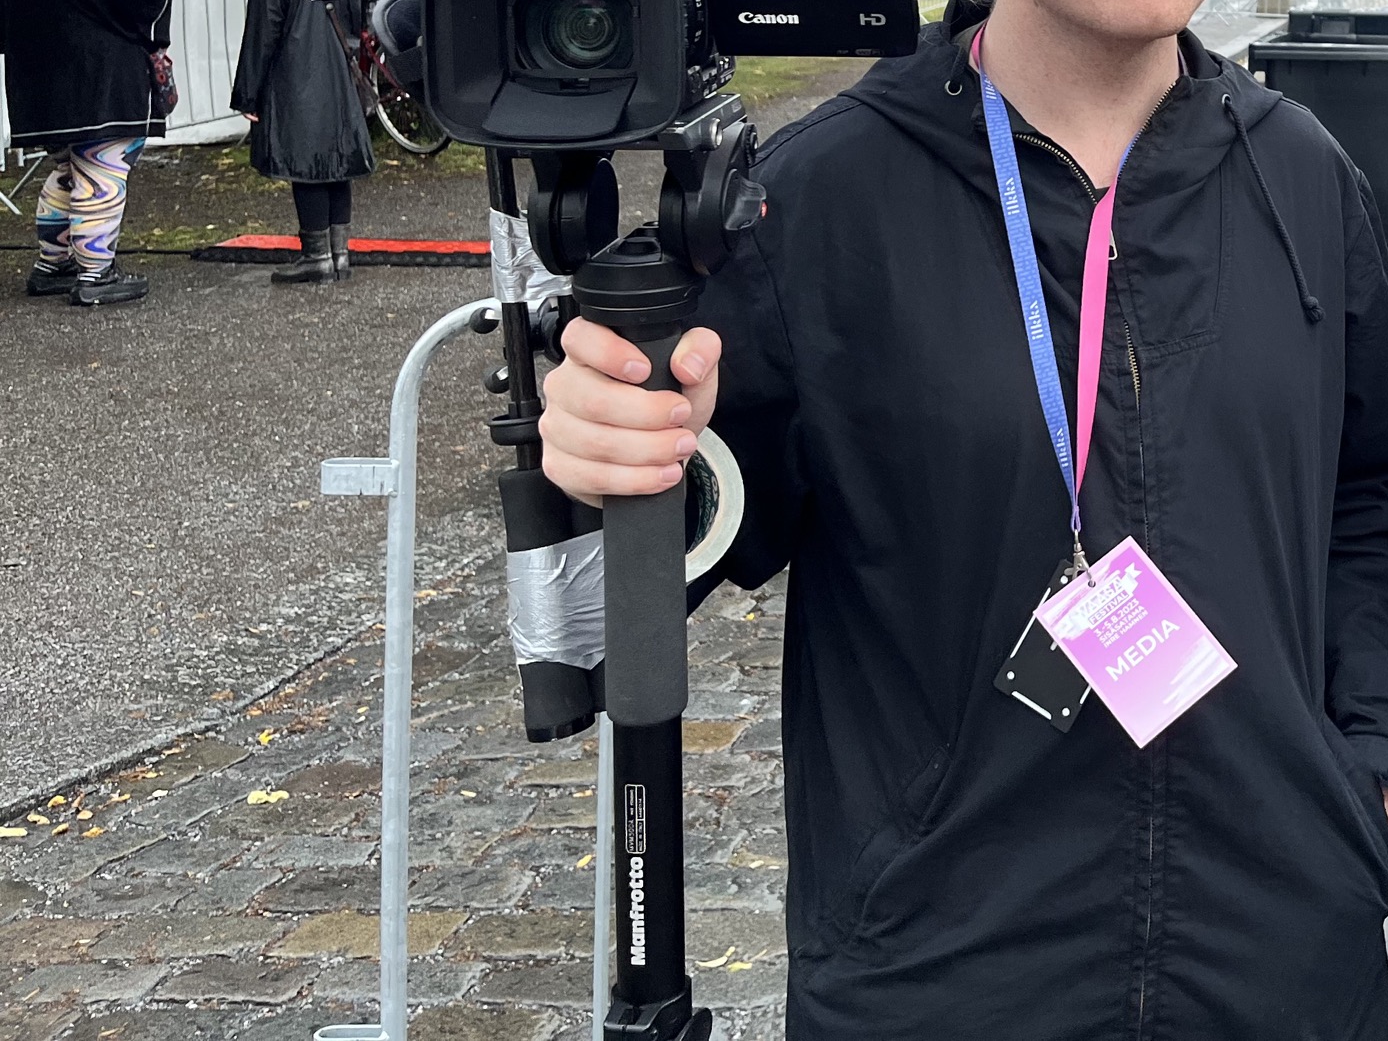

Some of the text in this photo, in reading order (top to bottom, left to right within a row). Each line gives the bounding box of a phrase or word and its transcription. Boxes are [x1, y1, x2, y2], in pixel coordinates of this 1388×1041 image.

[738, 11, 800, 25] Canon
[859, 13, 887, 26] HD
[1090, 590, 1129, 626] FESTIVAL
[1104, 619, 1181, 682] MEDIA
[630, 856, 646, 966] Manfrotto
